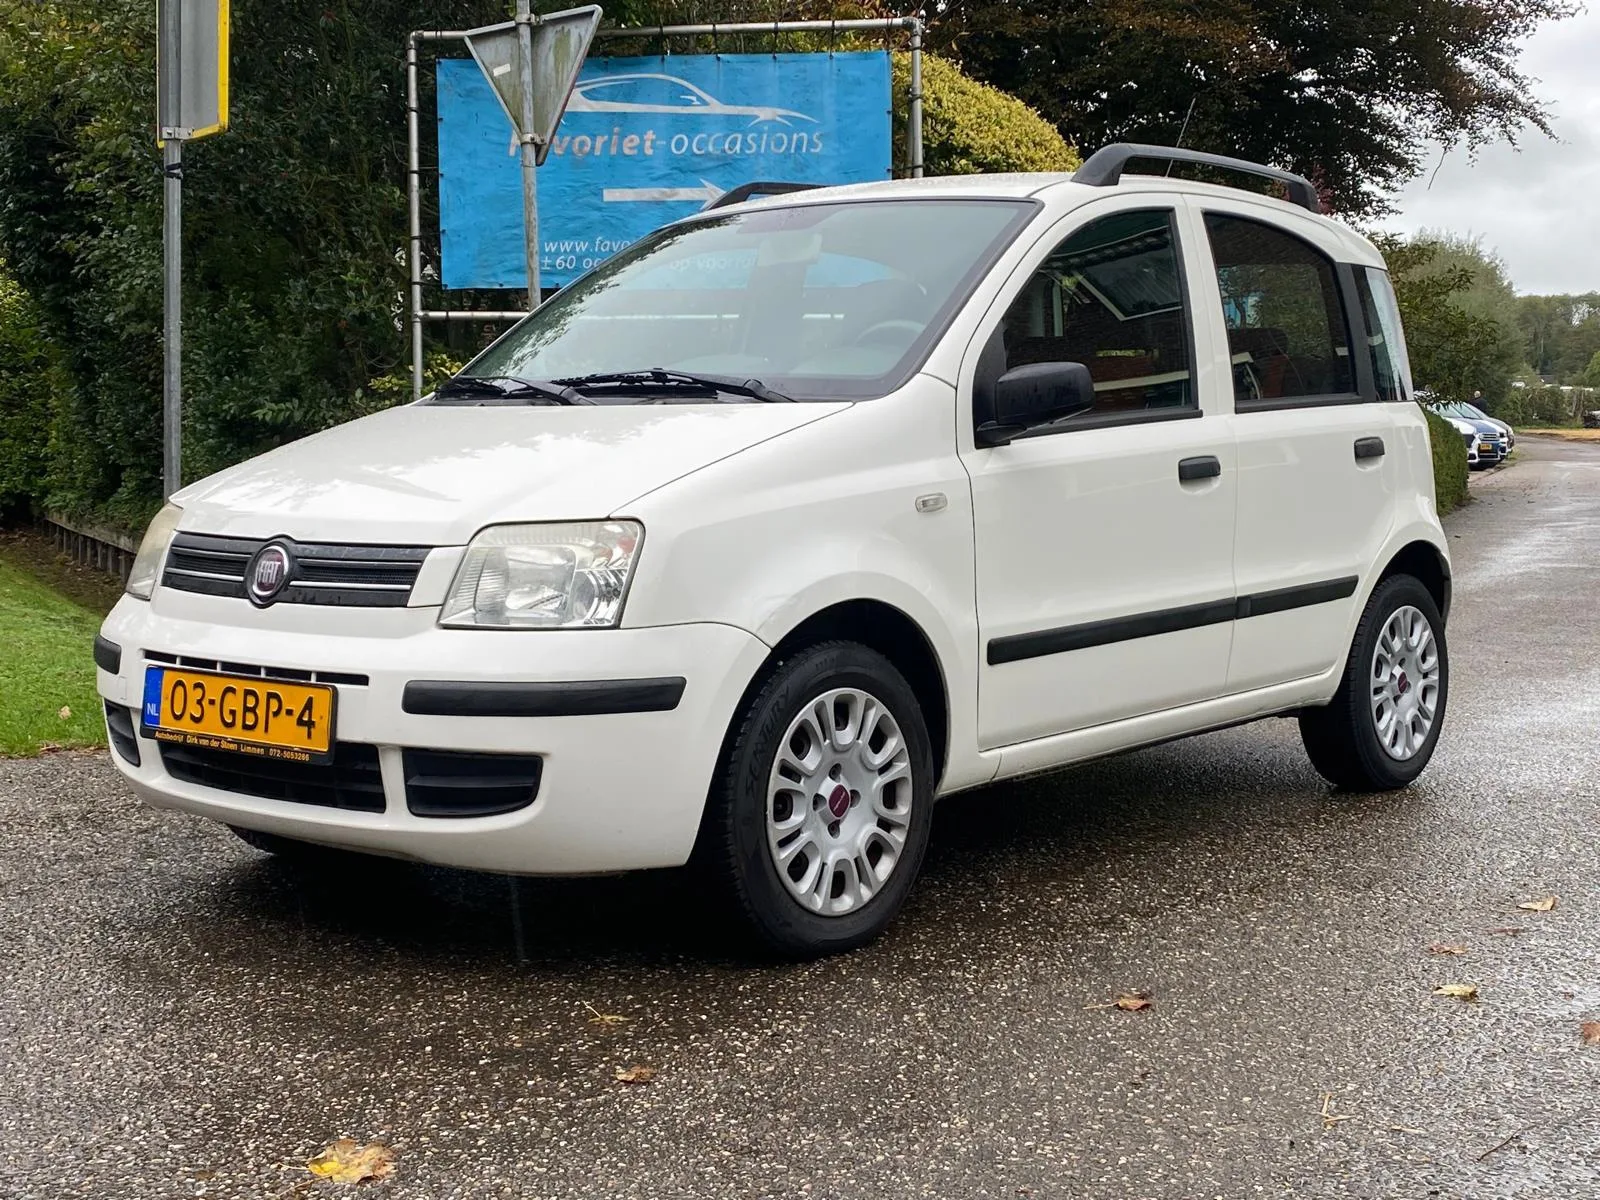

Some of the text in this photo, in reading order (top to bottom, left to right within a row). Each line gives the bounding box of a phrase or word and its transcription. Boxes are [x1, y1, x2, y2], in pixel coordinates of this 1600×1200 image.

[509, 122, 825, 156] Fvoriet-occasions
[544, 237, 631, 253] www.favo
[257, 560, 281, 584] FIAT
[146, 702, 159, 717] NL
[170, 679, 316, 740] 03-GBP-4
[186, 735, 198, 745] Dirk
[210, 739, 220, 747] der
[240, 743, 265, 755] Limmen
